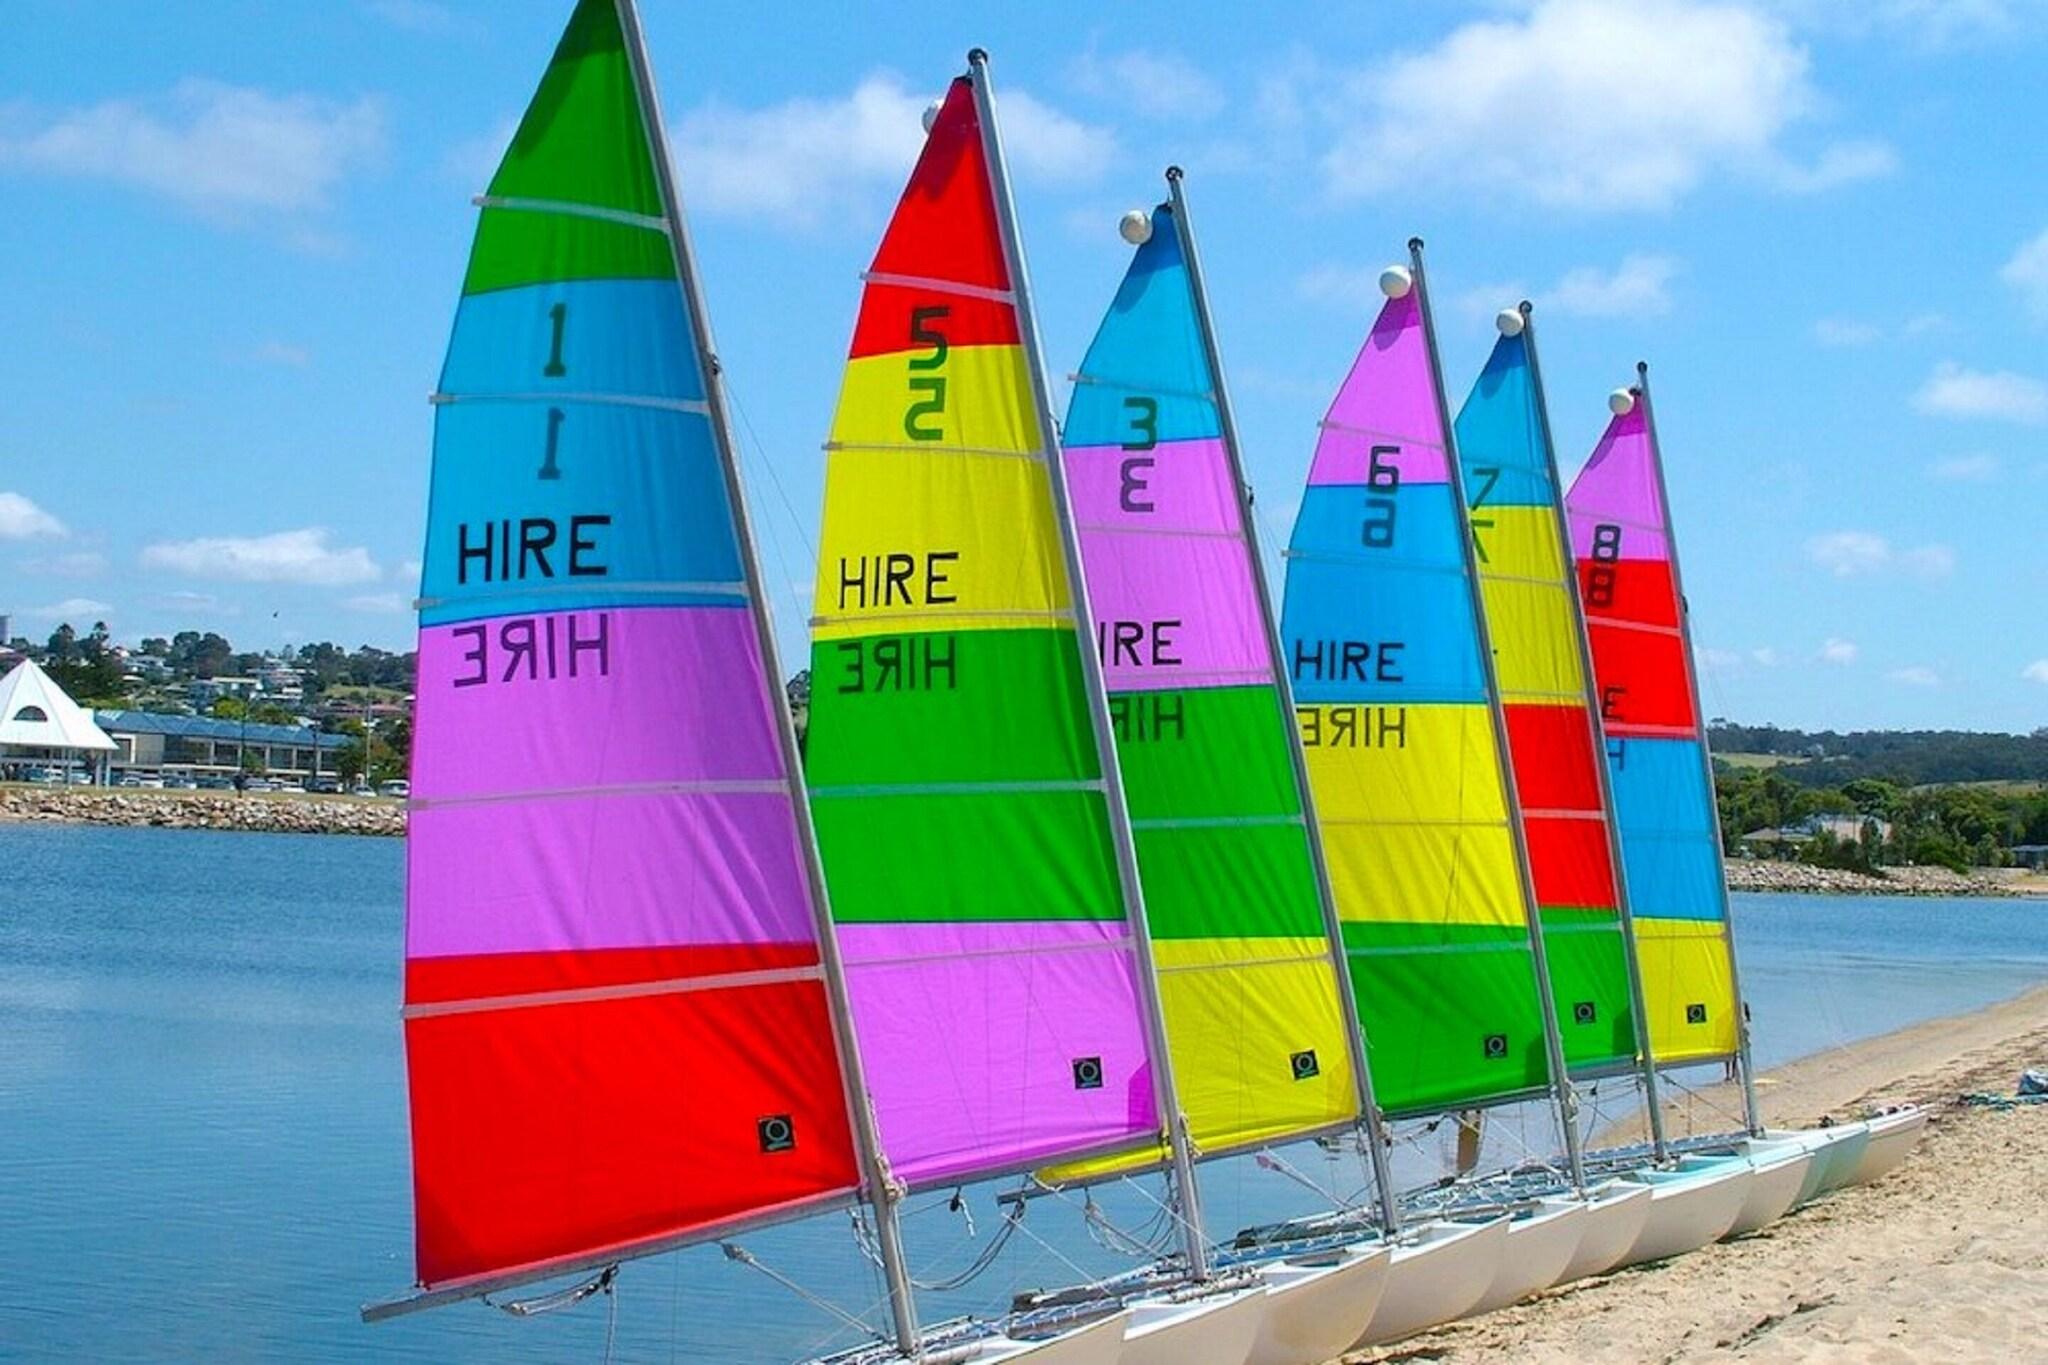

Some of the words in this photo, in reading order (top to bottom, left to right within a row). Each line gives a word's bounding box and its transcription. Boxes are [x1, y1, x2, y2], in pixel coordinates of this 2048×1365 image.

[544, 303, 566, 377] 1
[908, 306, 949, 370] 5
[1121, 396, 1158, 451] 3
[1368, 446, 1400, 495] 6
[1472, 468, 1500, 511] 7
[458, 514, 611, 585] HIRE
[1592, 524, 1620, 564] 8
[838, 551, 960, 609] HIRE
[1099, 620, 1183, 668] IRE
[1294, 638, 1405, 682] HIRE
